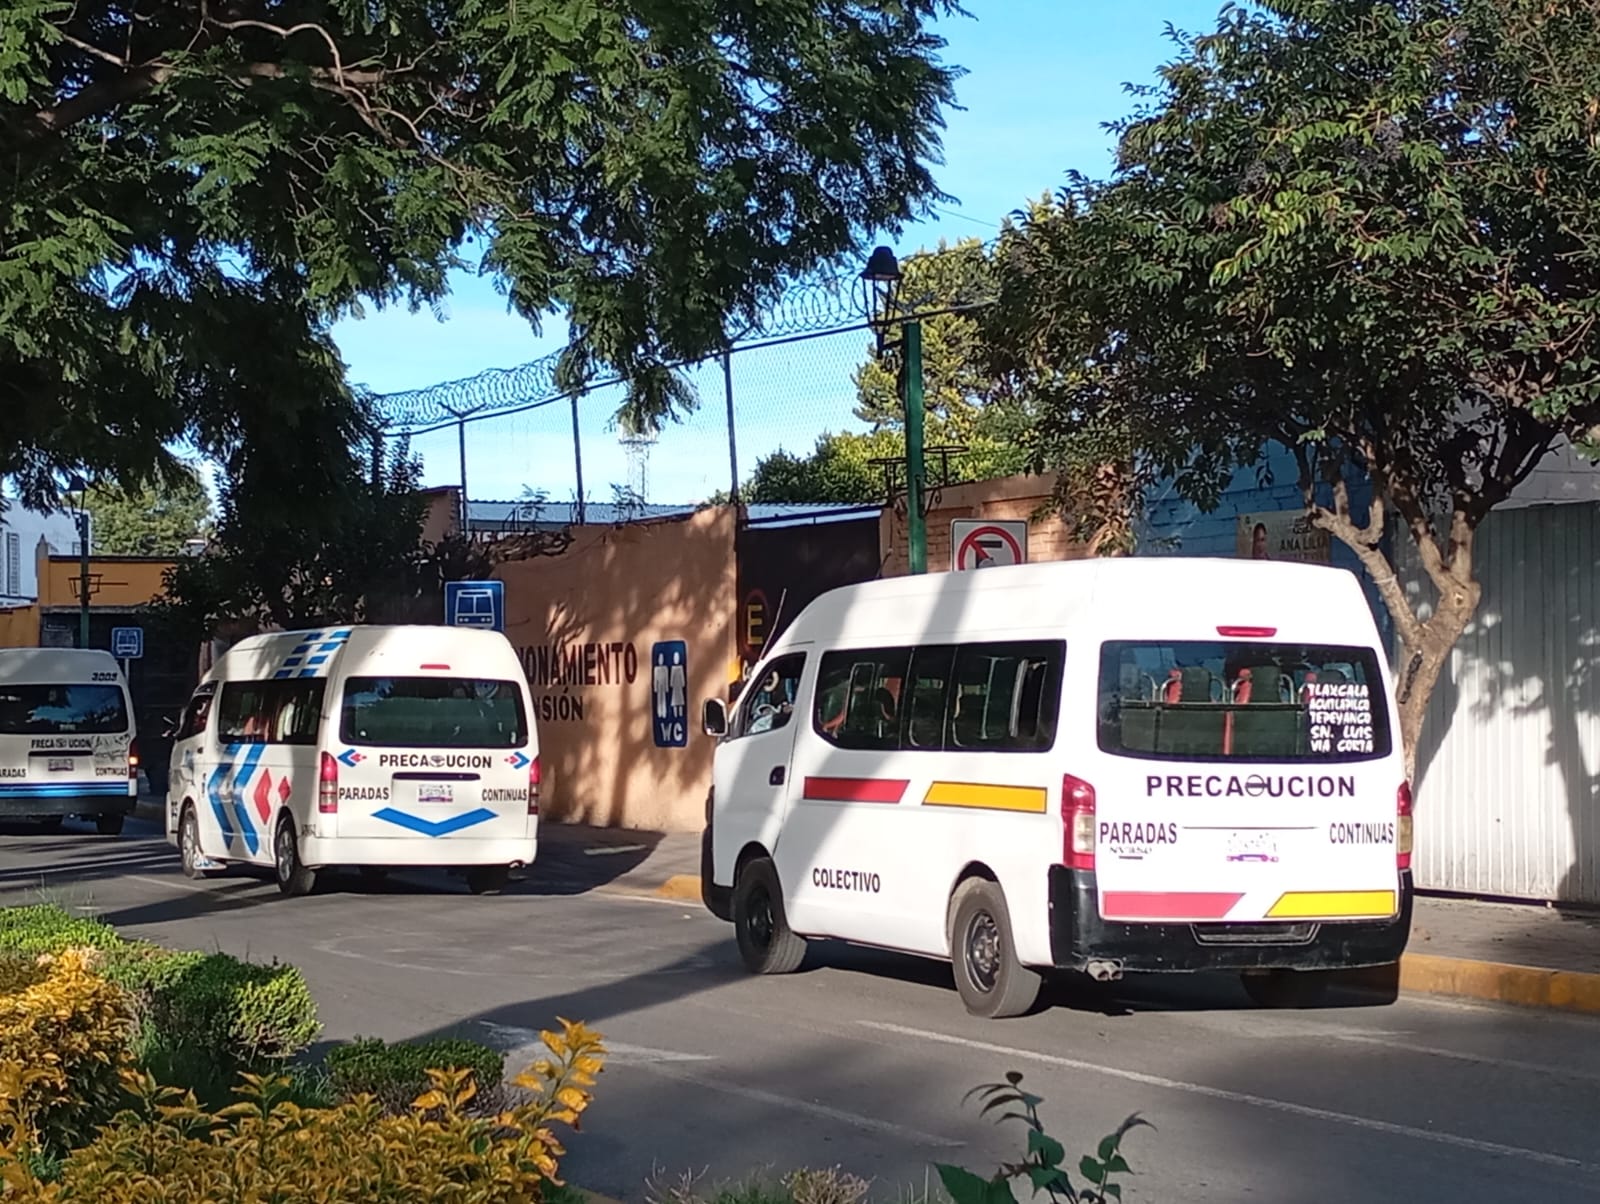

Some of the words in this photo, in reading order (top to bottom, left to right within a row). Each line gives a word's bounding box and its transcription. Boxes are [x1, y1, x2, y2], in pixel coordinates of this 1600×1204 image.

[1279, 537, 1301, 551] ANA
[747, 604, 763, 645] E
[1307, 683, 1369, 697] TLAXCALA
[1309, 711, 1372, 725] TEPEYANCO
[660, 722, 683, 741] WC
[1310, 725, 1334, 739] SN.
[1343, 725, 1373, 739] LUIS
[1310, 739, 1331, 752] VIA
[1337, 739, 1374, 753] CORTA
[339, 786, 389, 800] PARADAS
[482, 788, 527, 801] CONTINUAS
[1100, 822, 1177, 844] PARADAS
[1329, 822, 1394, 845] CONTINUAS
[812, 867, 881, 893] COLECTIVO
